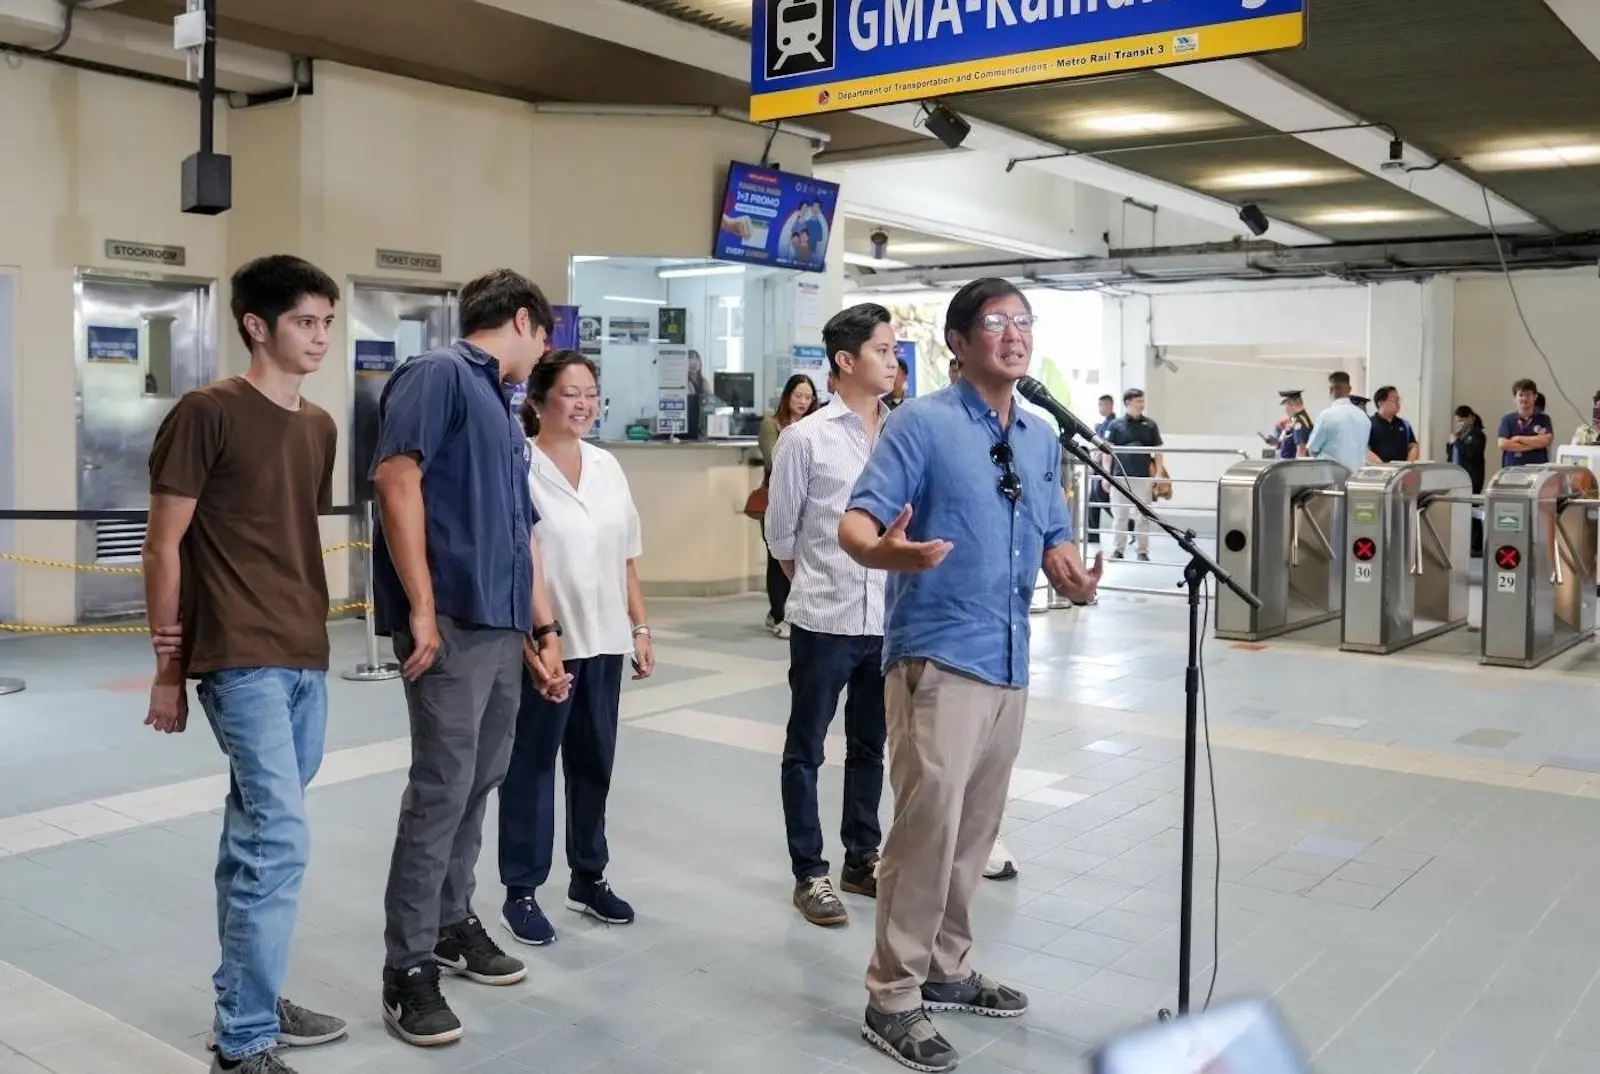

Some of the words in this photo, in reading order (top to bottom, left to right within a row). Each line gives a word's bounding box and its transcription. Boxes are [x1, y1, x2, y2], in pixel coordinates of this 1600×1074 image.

[838, 87, 882, 99] Department
[884, 84, 891, 93] of
[894, 77, 954, 91] Transportation
[956, 73, 971, 82] and
[974, 63, 1048, 79] Communications
[1056, 57, 1087, 67] Metro
[1090, 52, 1111, 62] Rail
[1115, 47, 1154, 59] Transit
[1158, 44, 1164, 53] 3
[750, 194, 780, 208] PROMO
[114, 245, 177, 260] STOCKROOM
[381, 254, 408, 266] TICKET
[1357, 567, 1370, 578] 30
[1499, 576, 1514, 588] 29
